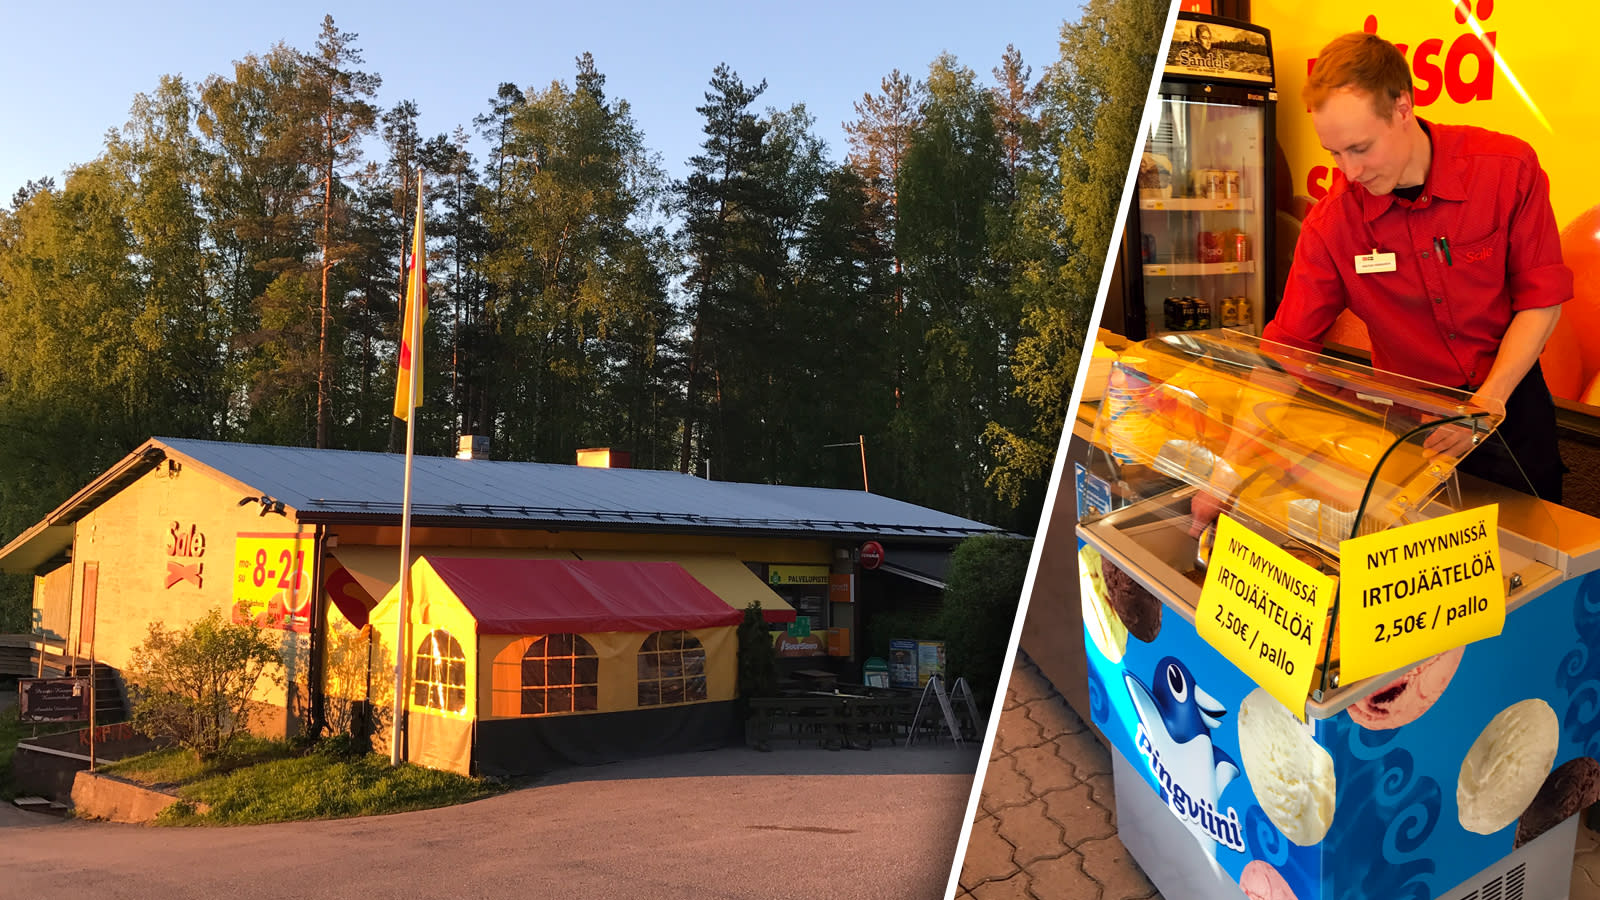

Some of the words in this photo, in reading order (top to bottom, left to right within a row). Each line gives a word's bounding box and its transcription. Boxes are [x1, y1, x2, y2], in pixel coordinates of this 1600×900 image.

[1180, 49, 1230, 71] Sandels
[167, 520, 206, 557] Sale
[1367, 547, 1399, 570] NYT
[1403, 520, 1487, 560] MYYNNISSÄ
[253, 548, 305, 590] 8-21
[788, 575, 829, 583] PALVELUPISTE
[1228, 537, 1249, 560] NYT
[1249, 552, 1318, 606] MYYNNISSÄ
[1363, 550, 1495, 608] IRTOJÄÄTELÖÄ
[1218, 566, 1314, 646] IRTOJÄÄTELÖÄ
[1374, 611, 1427, 643] 2,50€
[1431, 605, 1442, 630] /
[1447, 595, 1488, 626] pallo
[1214, 604, 1249, 642] 2,50€
[1248, 630, 1260, 650] /
[1259, 641, 1295, 676] pallo
[1137, 725, 1243, 849] Pingviini
